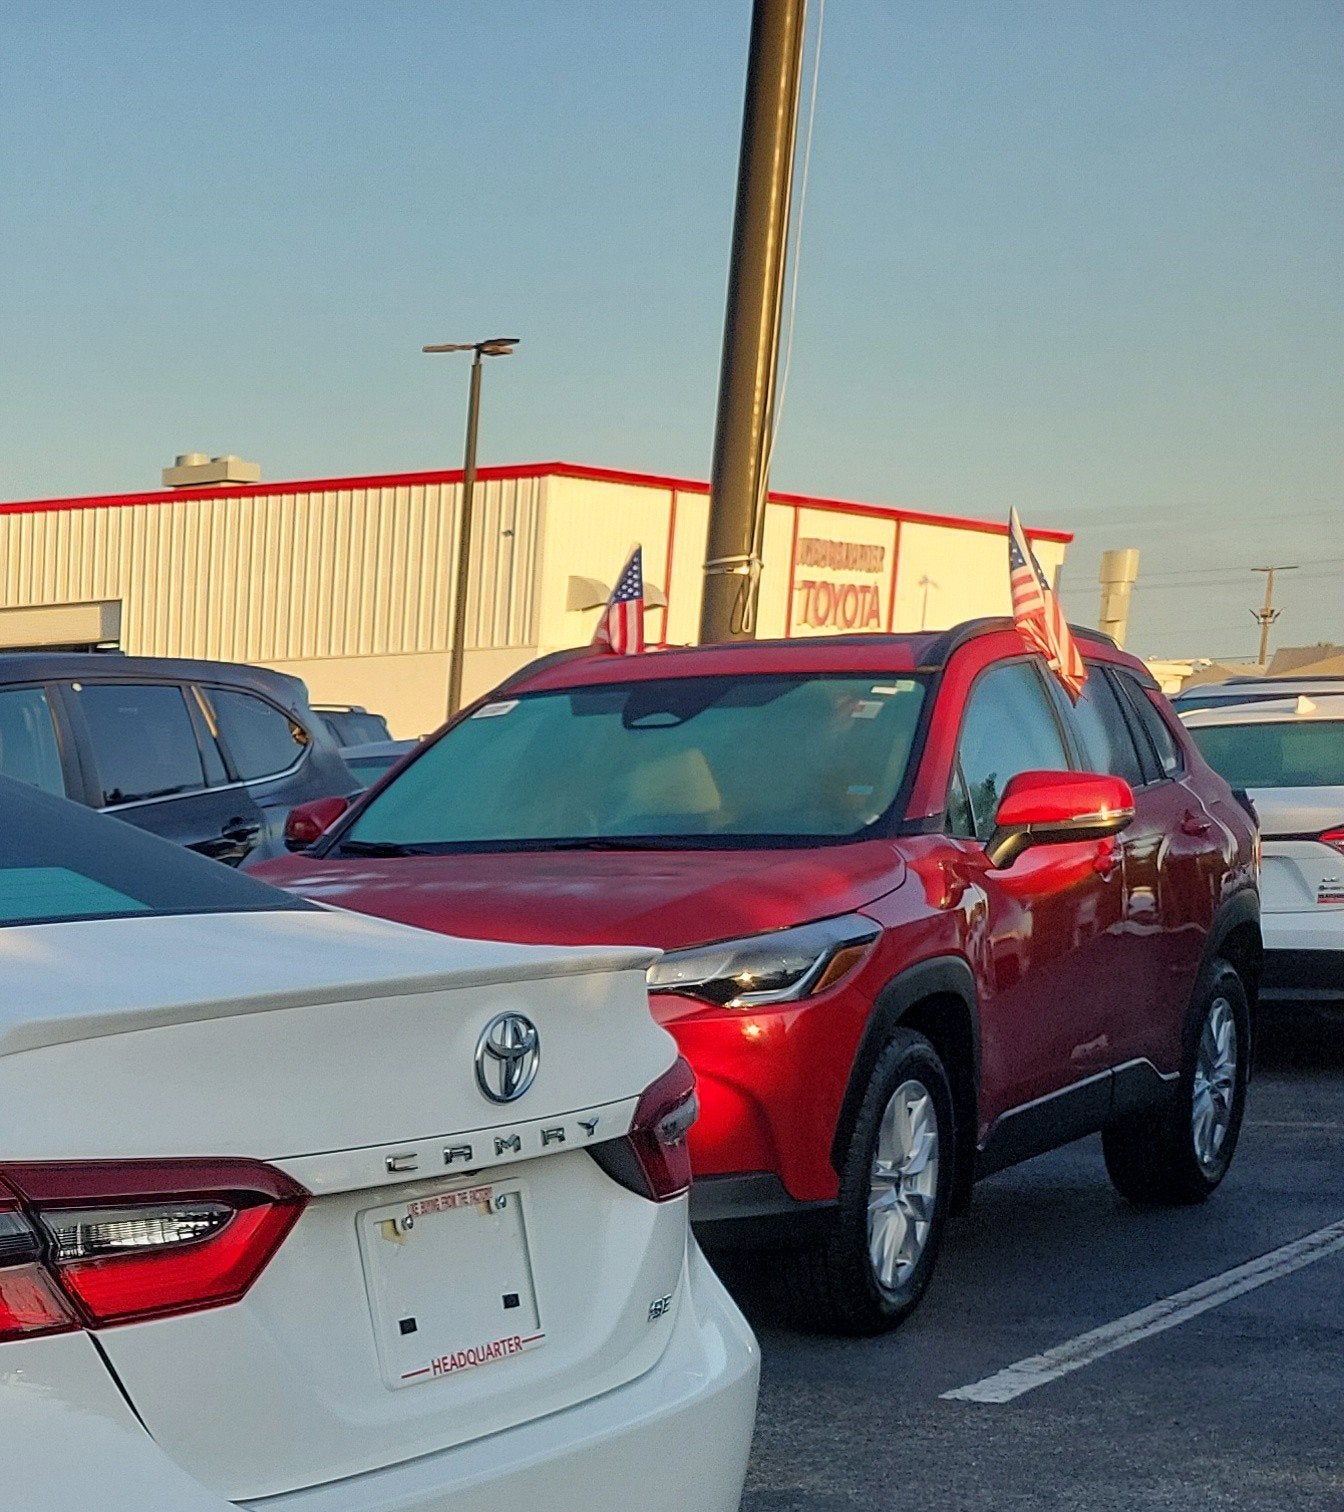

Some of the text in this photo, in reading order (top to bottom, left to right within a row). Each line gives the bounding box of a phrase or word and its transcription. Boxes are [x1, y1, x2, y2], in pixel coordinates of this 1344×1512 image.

[799, 580, 881, 628] TOYOTA
[385, 1116, 600, 1174] CAMRY
[431, 1335, 523, 1376] HEADQUARTER
